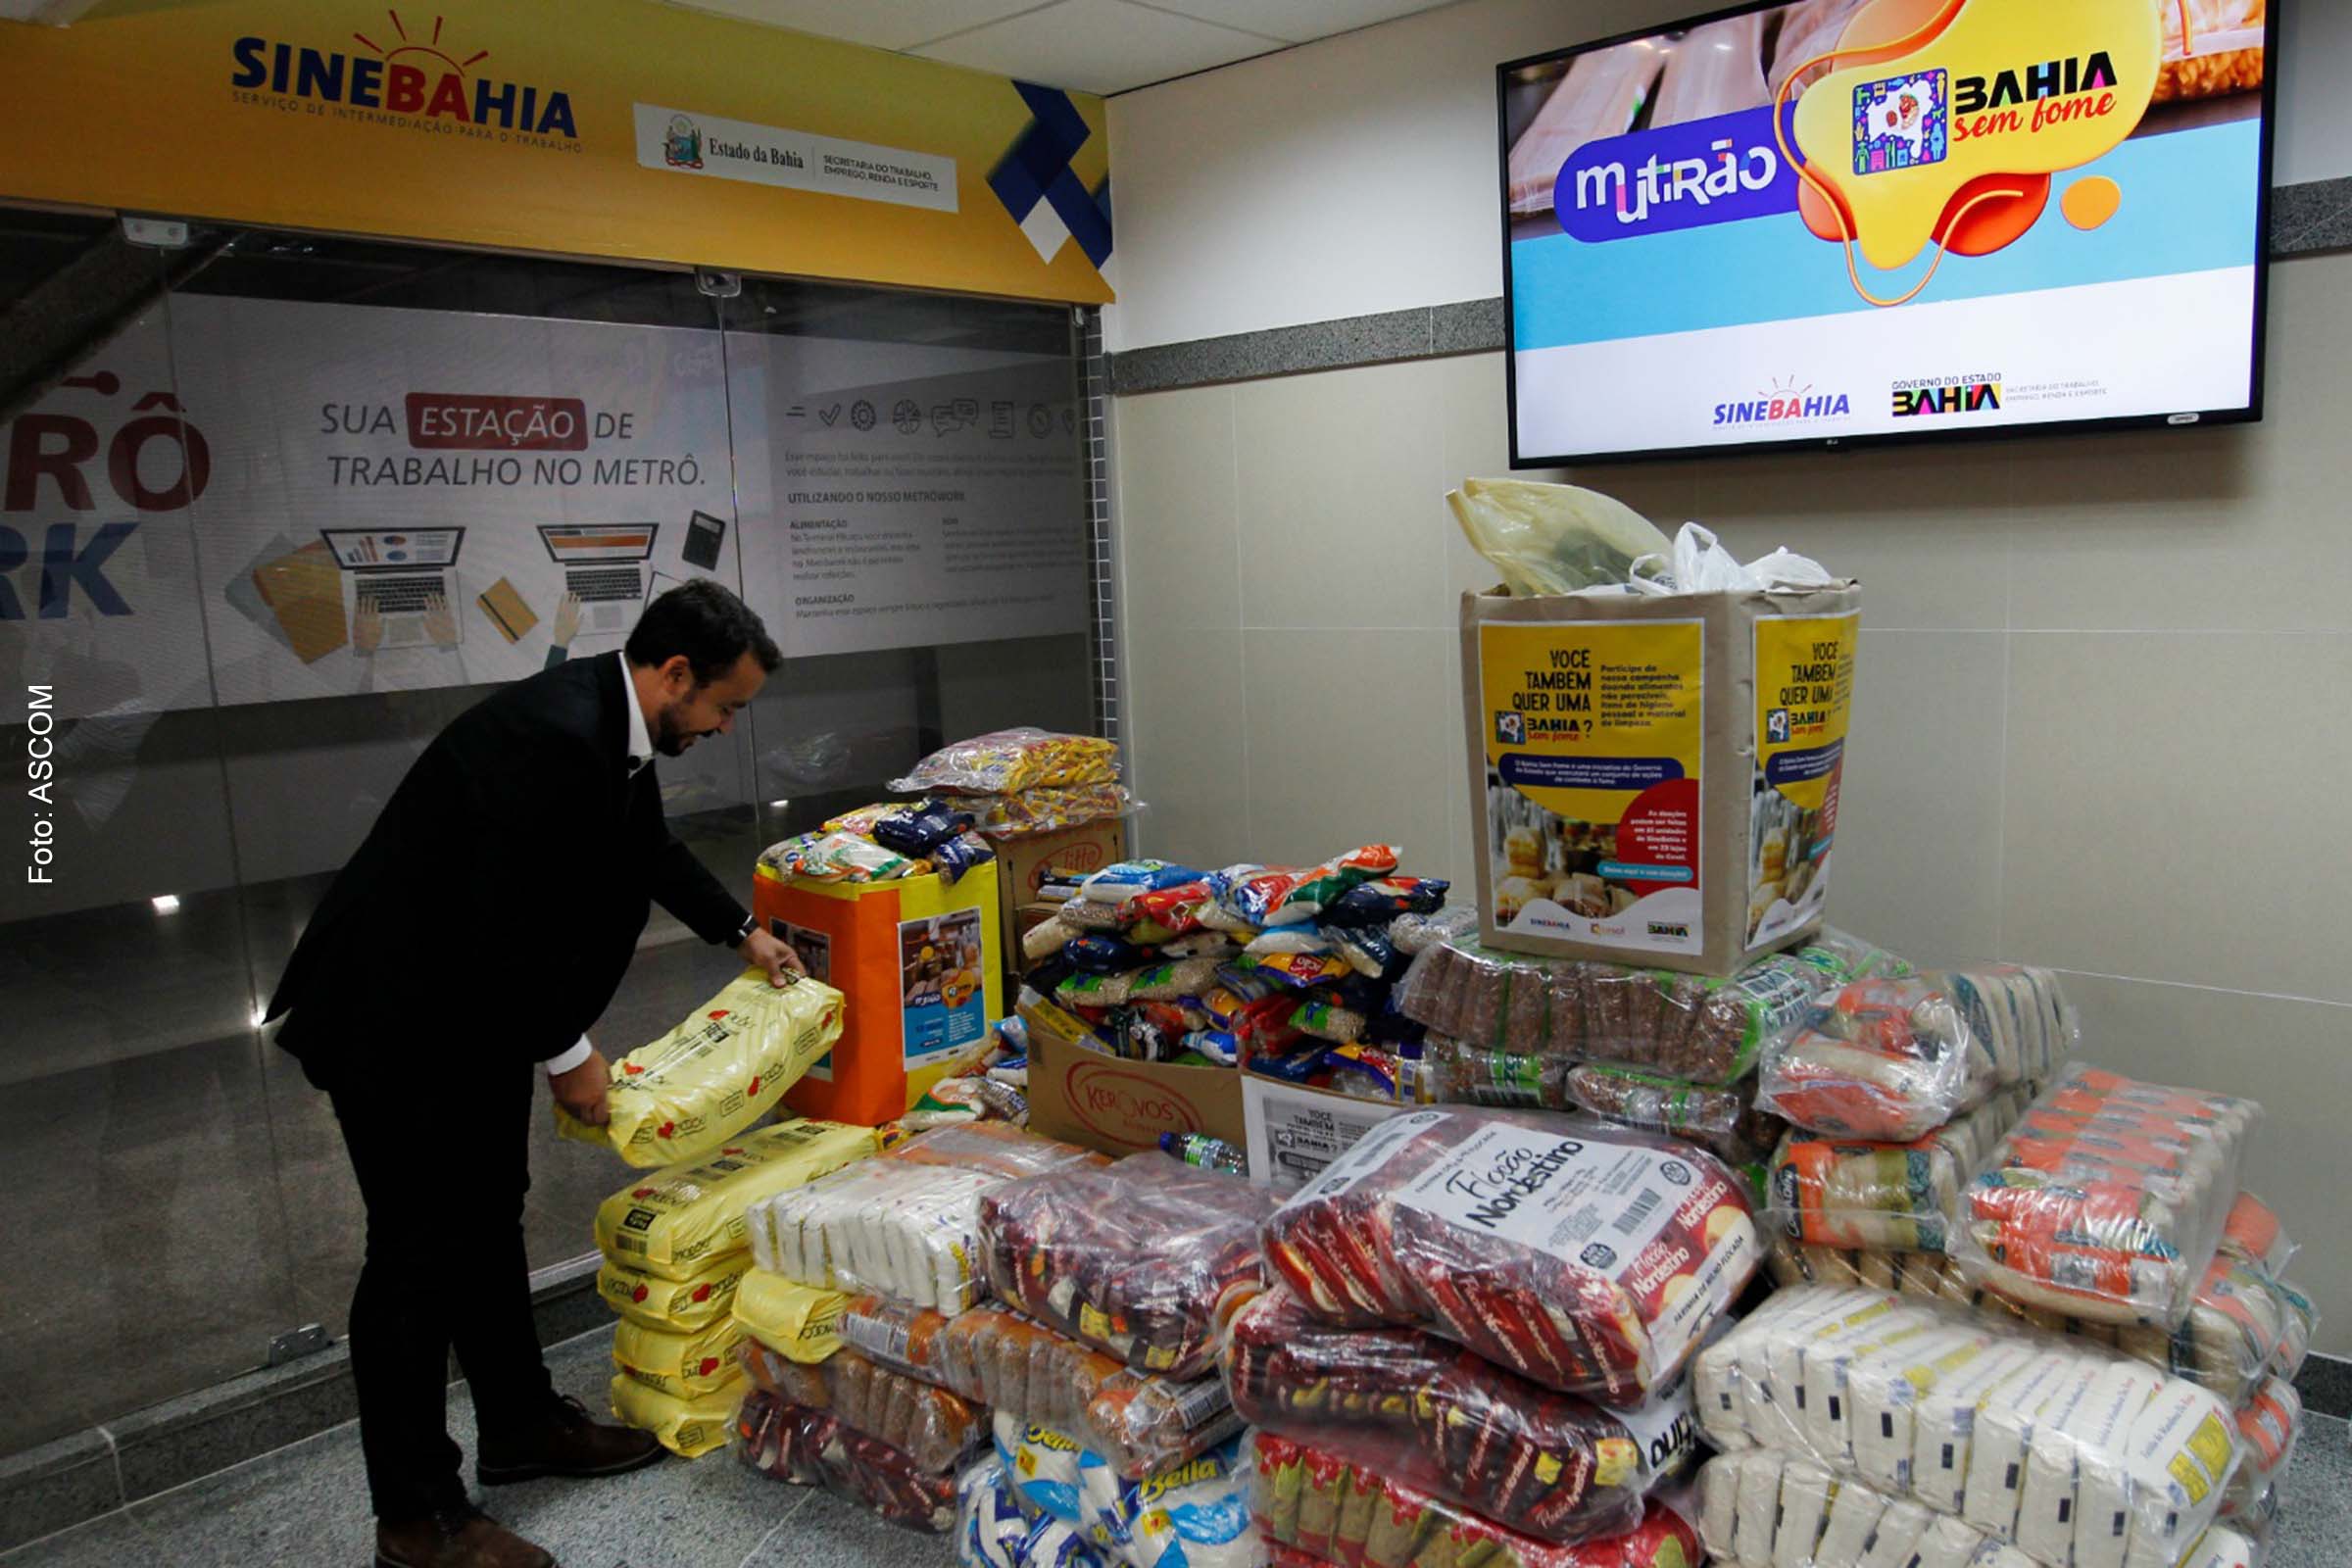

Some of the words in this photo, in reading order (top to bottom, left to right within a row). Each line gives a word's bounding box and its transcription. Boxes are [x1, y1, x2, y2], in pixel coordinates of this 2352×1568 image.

[231, 36, 578, 139] SINEBAHIA
[1955, 51, 2118, 115] BAHIA
[232, 90, 299, 113] SERVIÇO
[307, 103, 325, 117] DE
[332, 108, 452, 135] INTERMEDIAÇÃO
[459, 124, 493, 142] PARA
[500, 131, 509, 143] O
[515, 133, 582, 155] TRABALHO
[1952, 110, 2024, 142] sem
[2031, 92, 2117, 132] fome
[709, 137, 751, 163] Estado
[753, 145, 768, 165] da
[770, 147, 805, 170] Bahia
[823, 154, 874, 172] SECRETARIA
[875, 163, 889, 173] DO
[868, 171, 897, 185] RENDA
[898, 175, 905, 186] E
[905, 175, 940, 192] ESPORTE
[1892, 377, 1941, 389] GOVERNO
[1944, 375, 1959, 385] DO
[1962, 372, 2002, 383] ESTADO
[1892, 383, 2001, 416] BAHIA
[321, 403, 396, 434] SUA
[419, 405, 575, 447] ESTAÇÃO
[594, 413, 634, 439] DE
[1713, 394, 1850, 424] SINEBAHIA
[328, 456, 520, 487] TRABALHO
[533, 458, 582, 485] NO
[593, 453, 706, 486] METRÔ.
[788, 491, 855, 504] UTILIZANDO
[856, 491, 864, 503] O
[866, 491, 902, 503] NOSSO
[1512, 691, 1550, 711] QUER
[1555, 692, 1592, 712] UMA
[1779, 687, 1808, 706] QUER
[1527, 717, 1580, 732] BAHIA
[1583, 719, 1593, 739] ?
[1446, 1147, 1534, 1201] Flocão
[1465, 1140, 1585, 1229] Nordestino
[1675, 1181, 1729, 1232] Nordestino
[1631, 1247, 1690, 1299] Nordestino
[1673, 1293, 1700, 1325] FARINHA
[1697, 1283, 1707, 1296] DE
[1720, 1235, 1744, 1267] FLOCADA
[1140, 1457, 1218, 1504] Bella
